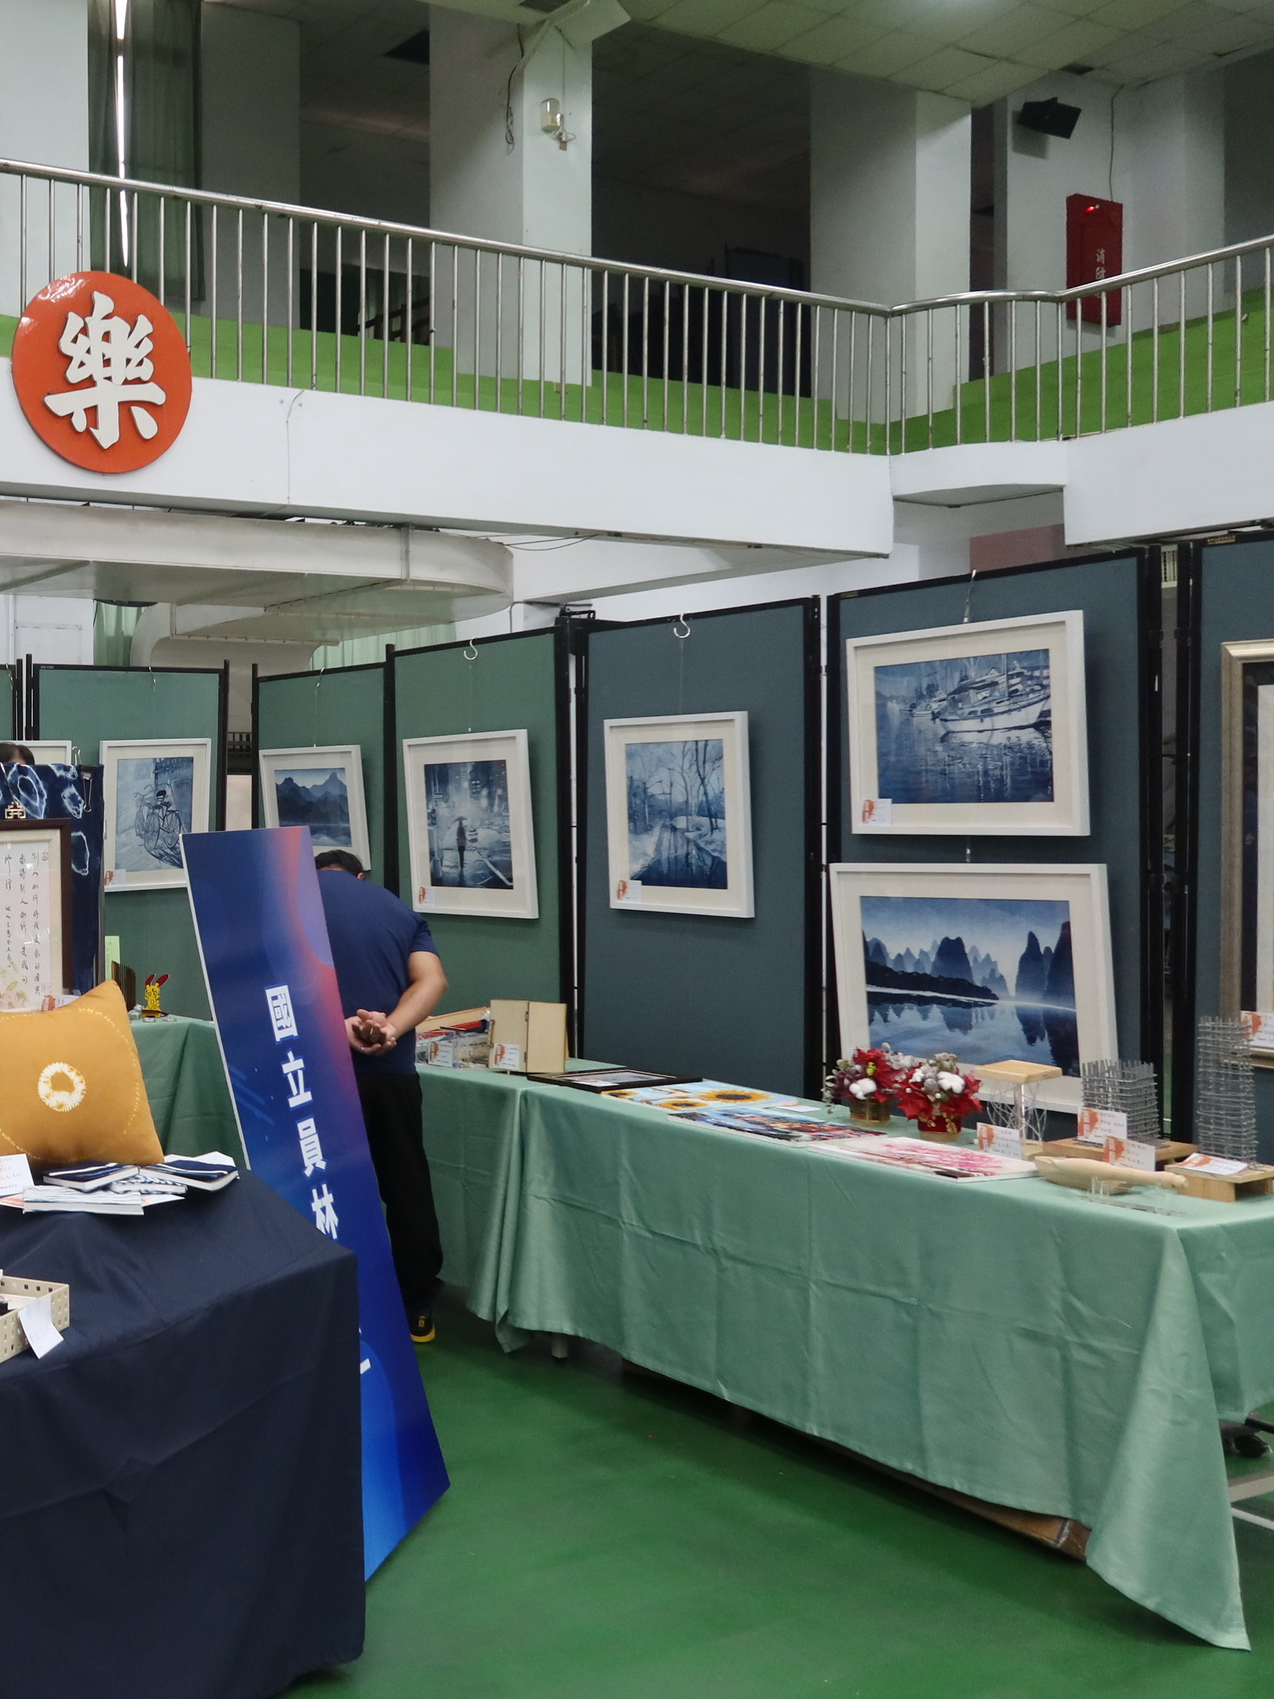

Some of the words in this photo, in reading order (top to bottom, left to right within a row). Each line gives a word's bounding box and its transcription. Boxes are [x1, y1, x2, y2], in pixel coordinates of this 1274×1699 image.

[1096, 248, 1107, 300] 消防
[43, 290, 167, 450] 樂
[265, 985, 339, 1240] 國立員林
